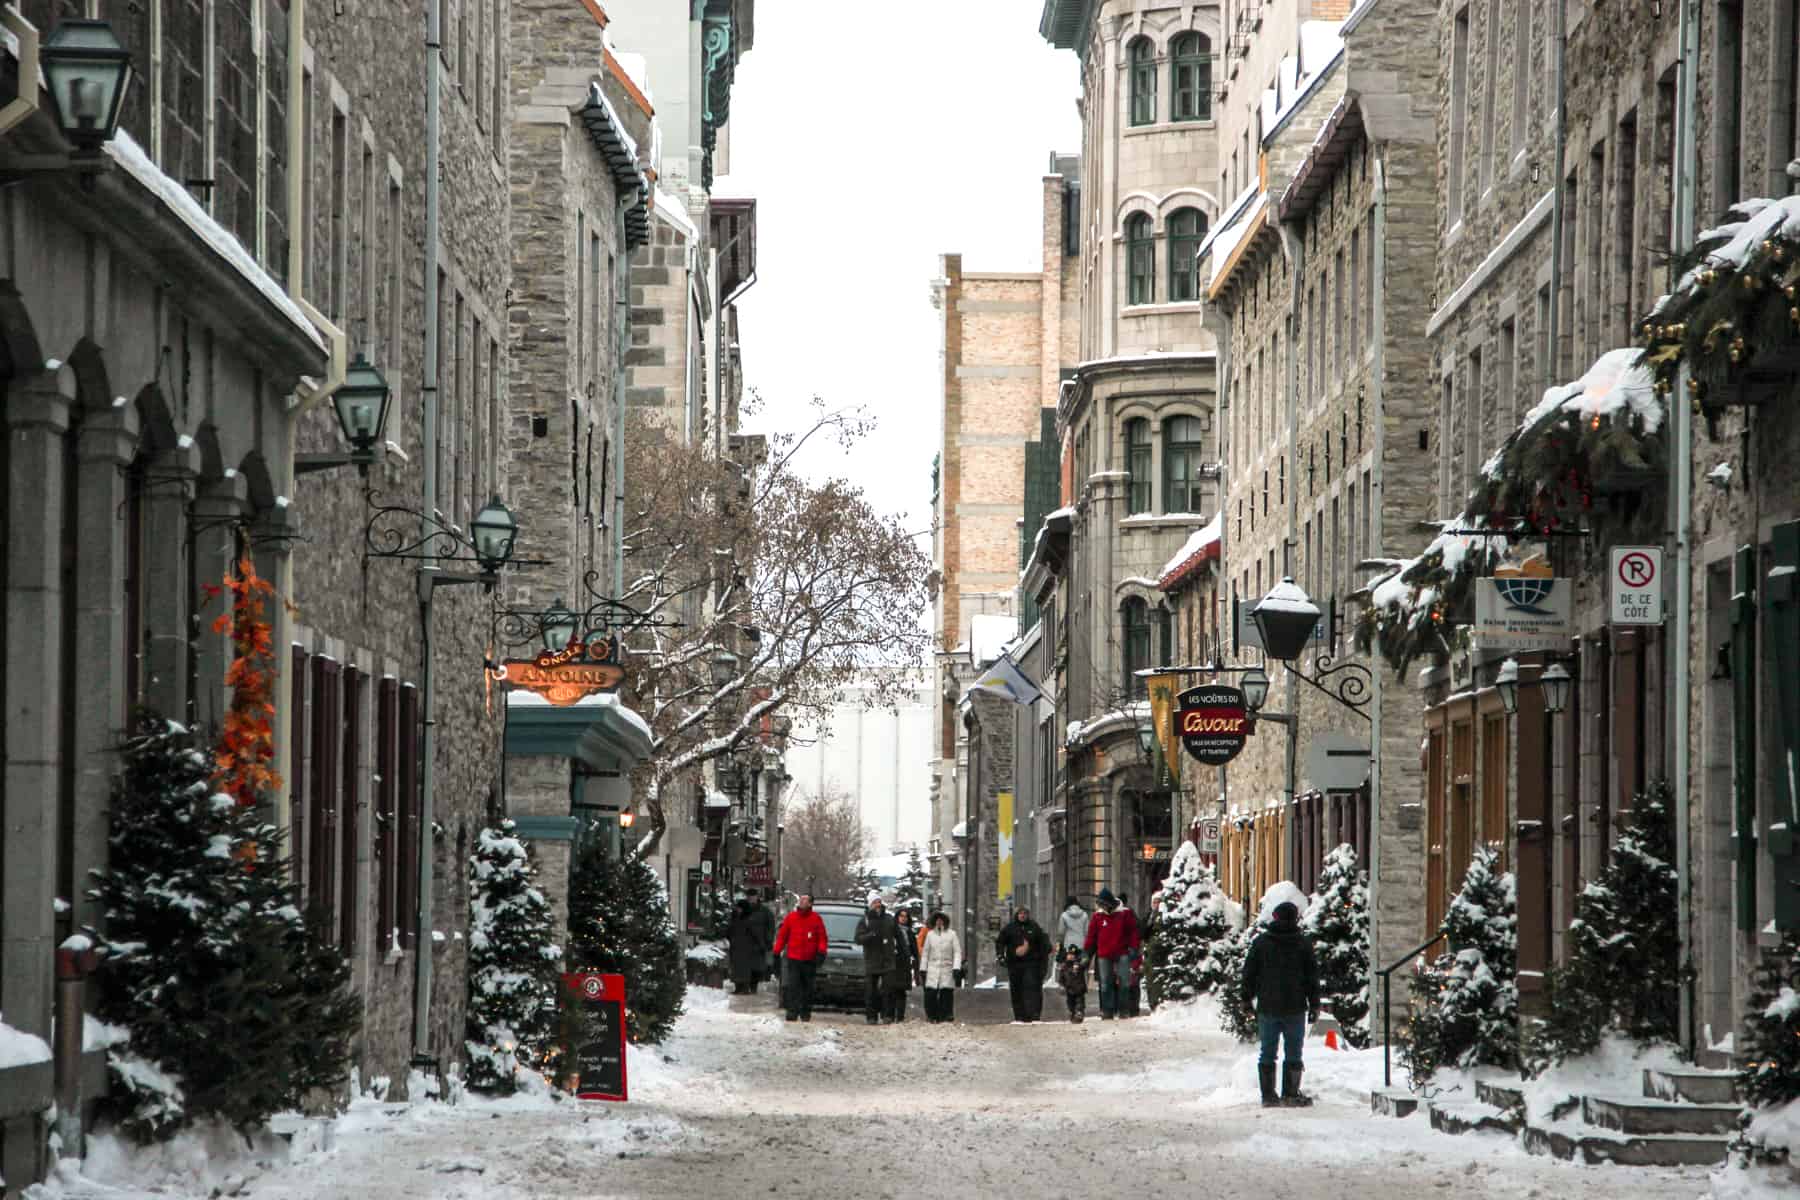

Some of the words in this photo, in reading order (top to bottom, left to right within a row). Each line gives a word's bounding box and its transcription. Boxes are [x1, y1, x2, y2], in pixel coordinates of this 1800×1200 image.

[1620, 594, 1632, 604] DE
[1639, 594, 1652, 604] CE
[1623, 604, 1649, 618] CÔTÉ
[540, 645, 583, 666] ONCLE
[520, 669, 607, 684] ANTOINE
[1188, 695, 1200, 703] LES
[1200, 693, 1228, 704] VOÛTES
[1228, 695, 1239, 704] DU
[1183, 711, 1244, 732] Cavour
